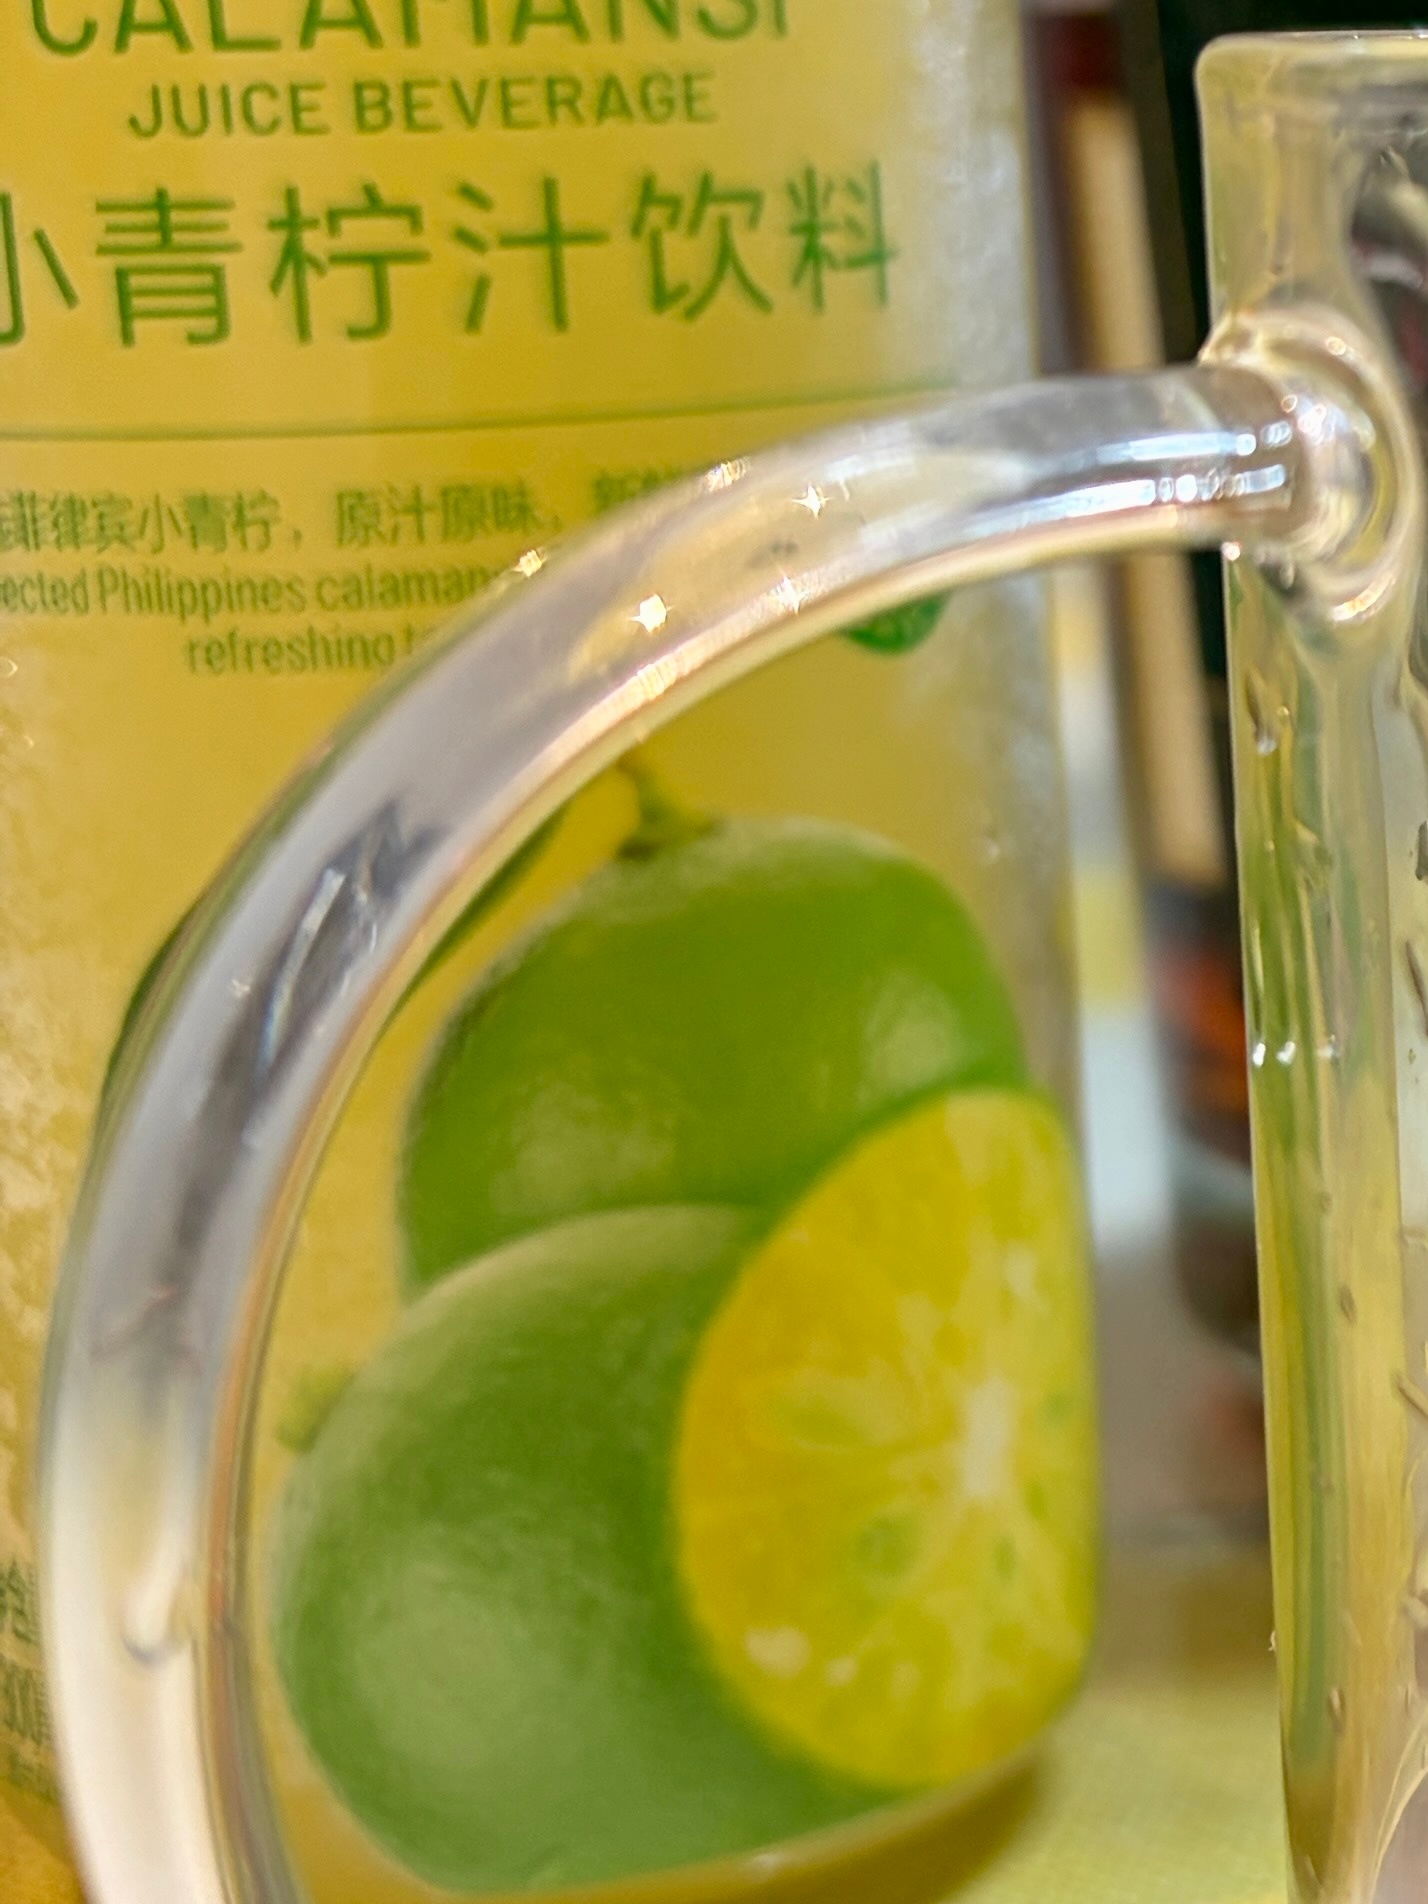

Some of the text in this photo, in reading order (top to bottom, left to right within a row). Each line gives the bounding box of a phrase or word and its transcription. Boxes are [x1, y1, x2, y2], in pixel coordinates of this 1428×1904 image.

[128, 70, 720, 140] JUICE BEVERAGE
[0, 158, 900, 349] 小青柠汁饮料
[96, 561, 306, 629] Philippines
